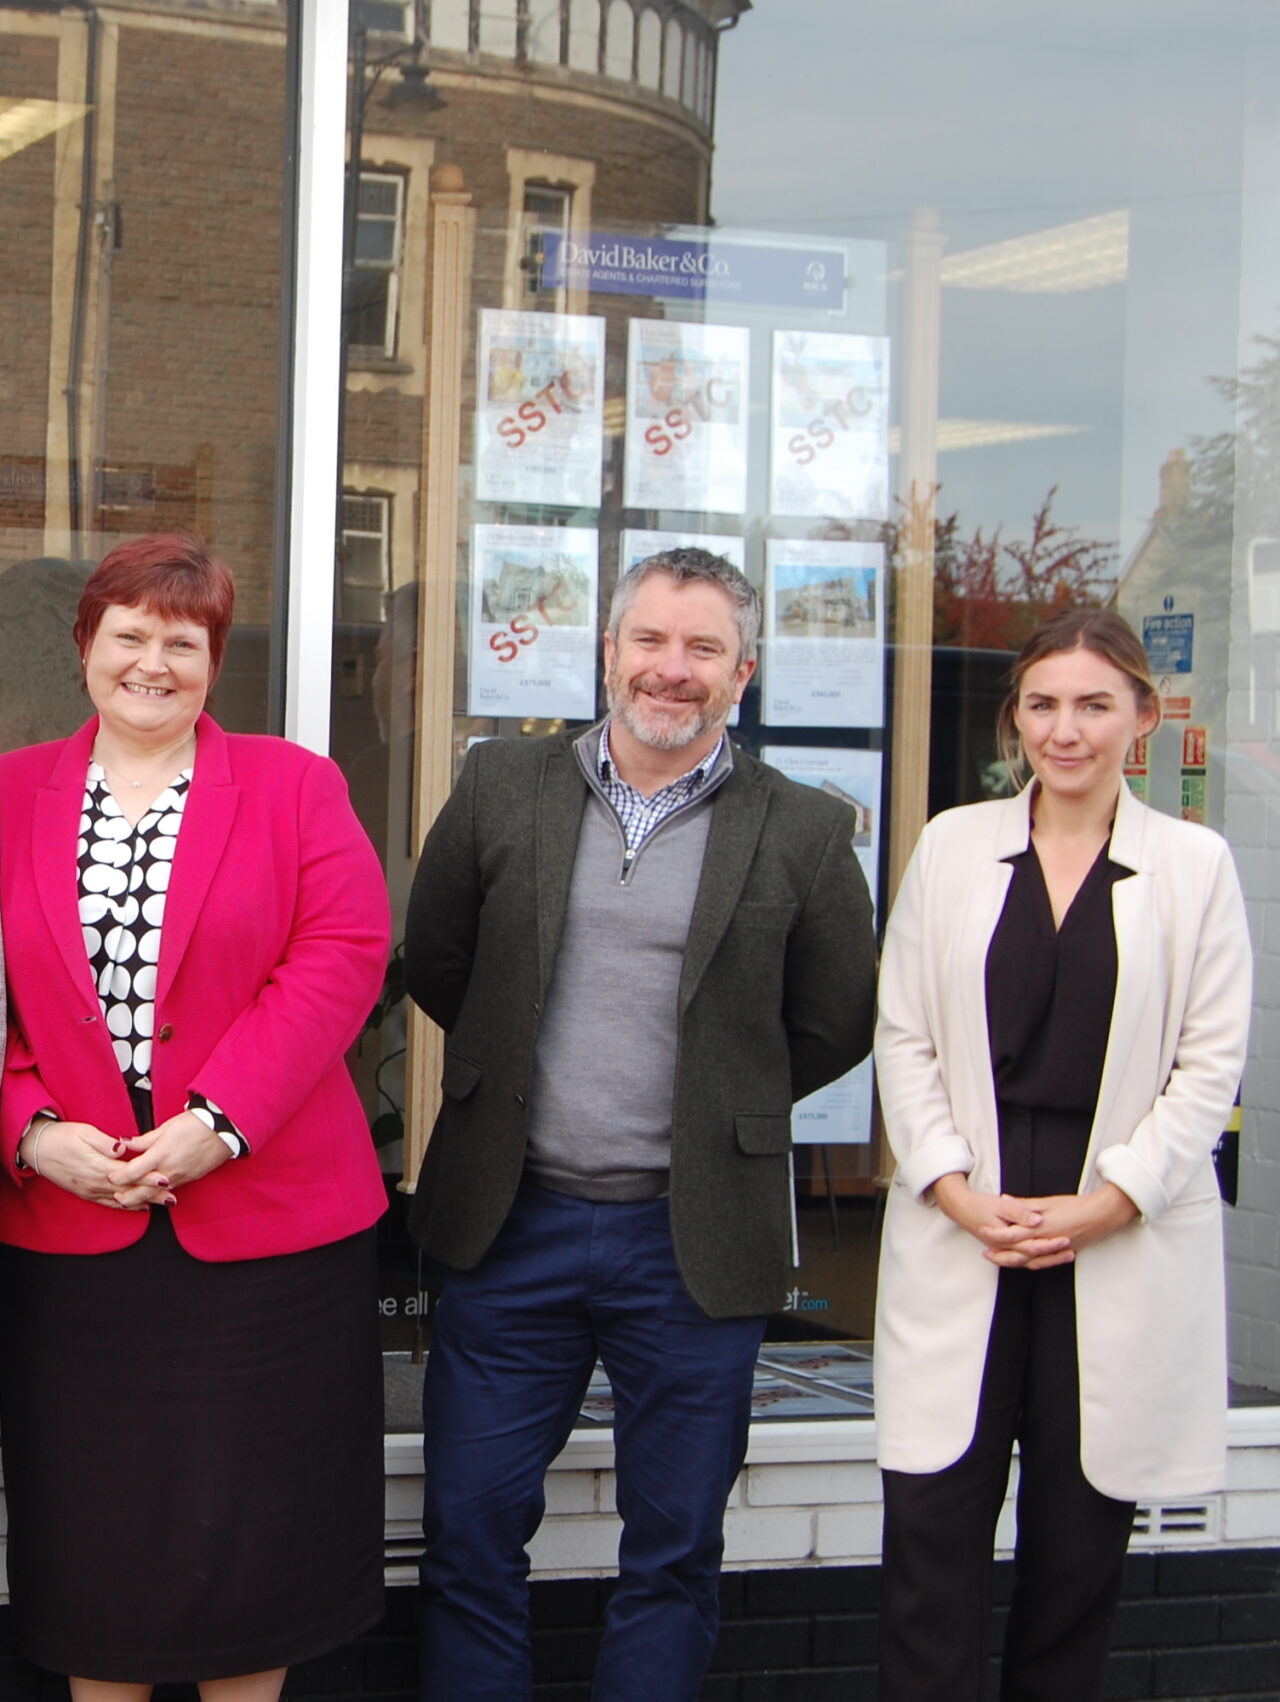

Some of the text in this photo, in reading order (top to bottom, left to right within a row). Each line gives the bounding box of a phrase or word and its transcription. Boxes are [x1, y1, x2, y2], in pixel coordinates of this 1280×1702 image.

[592, 269, 627, 281] AGENTS
[636, 273, 688, 286] CHARTERED
[497, 368, 590, 449] SSTC
[644, 377, 728, 457] SSTC
[788, 387, 874, 466] SSTC
[489, 580, 578, 664] SSTC
[1144, 615, 1192, 630] Fire action
[404, 1290, 428, 1316] all
